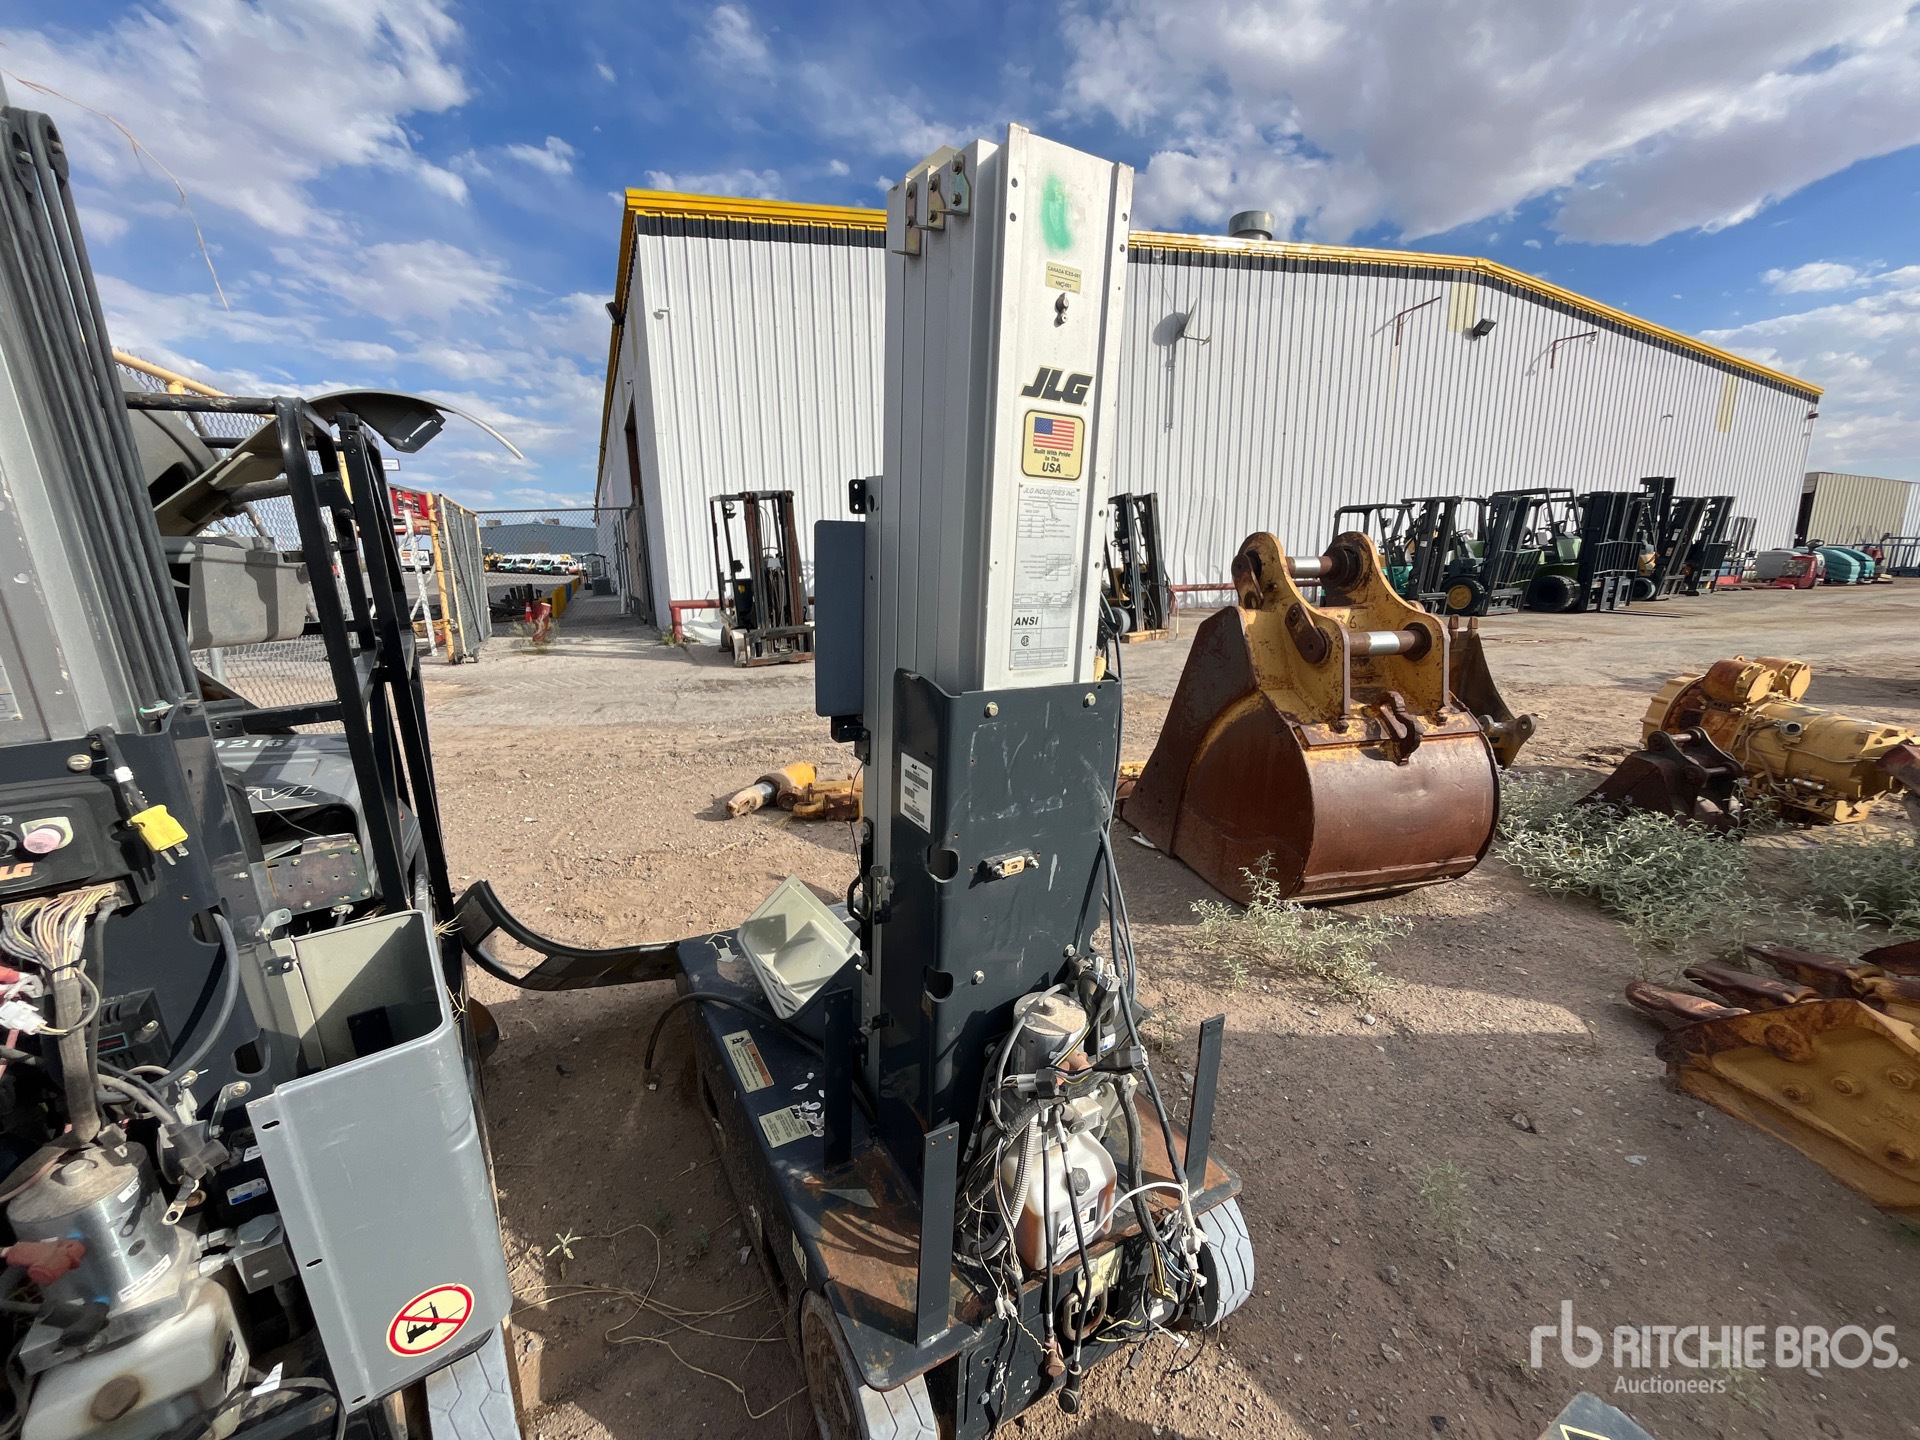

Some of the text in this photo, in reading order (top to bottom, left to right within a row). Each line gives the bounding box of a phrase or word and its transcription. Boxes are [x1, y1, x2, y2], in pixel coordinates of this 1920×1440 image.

[1021, 367, 1093, 405] JLG
[1042, 462, 1061, 473] USA
[1013, 616, 1039, 627] ANSI
[0, 862, 35, 881] LG
